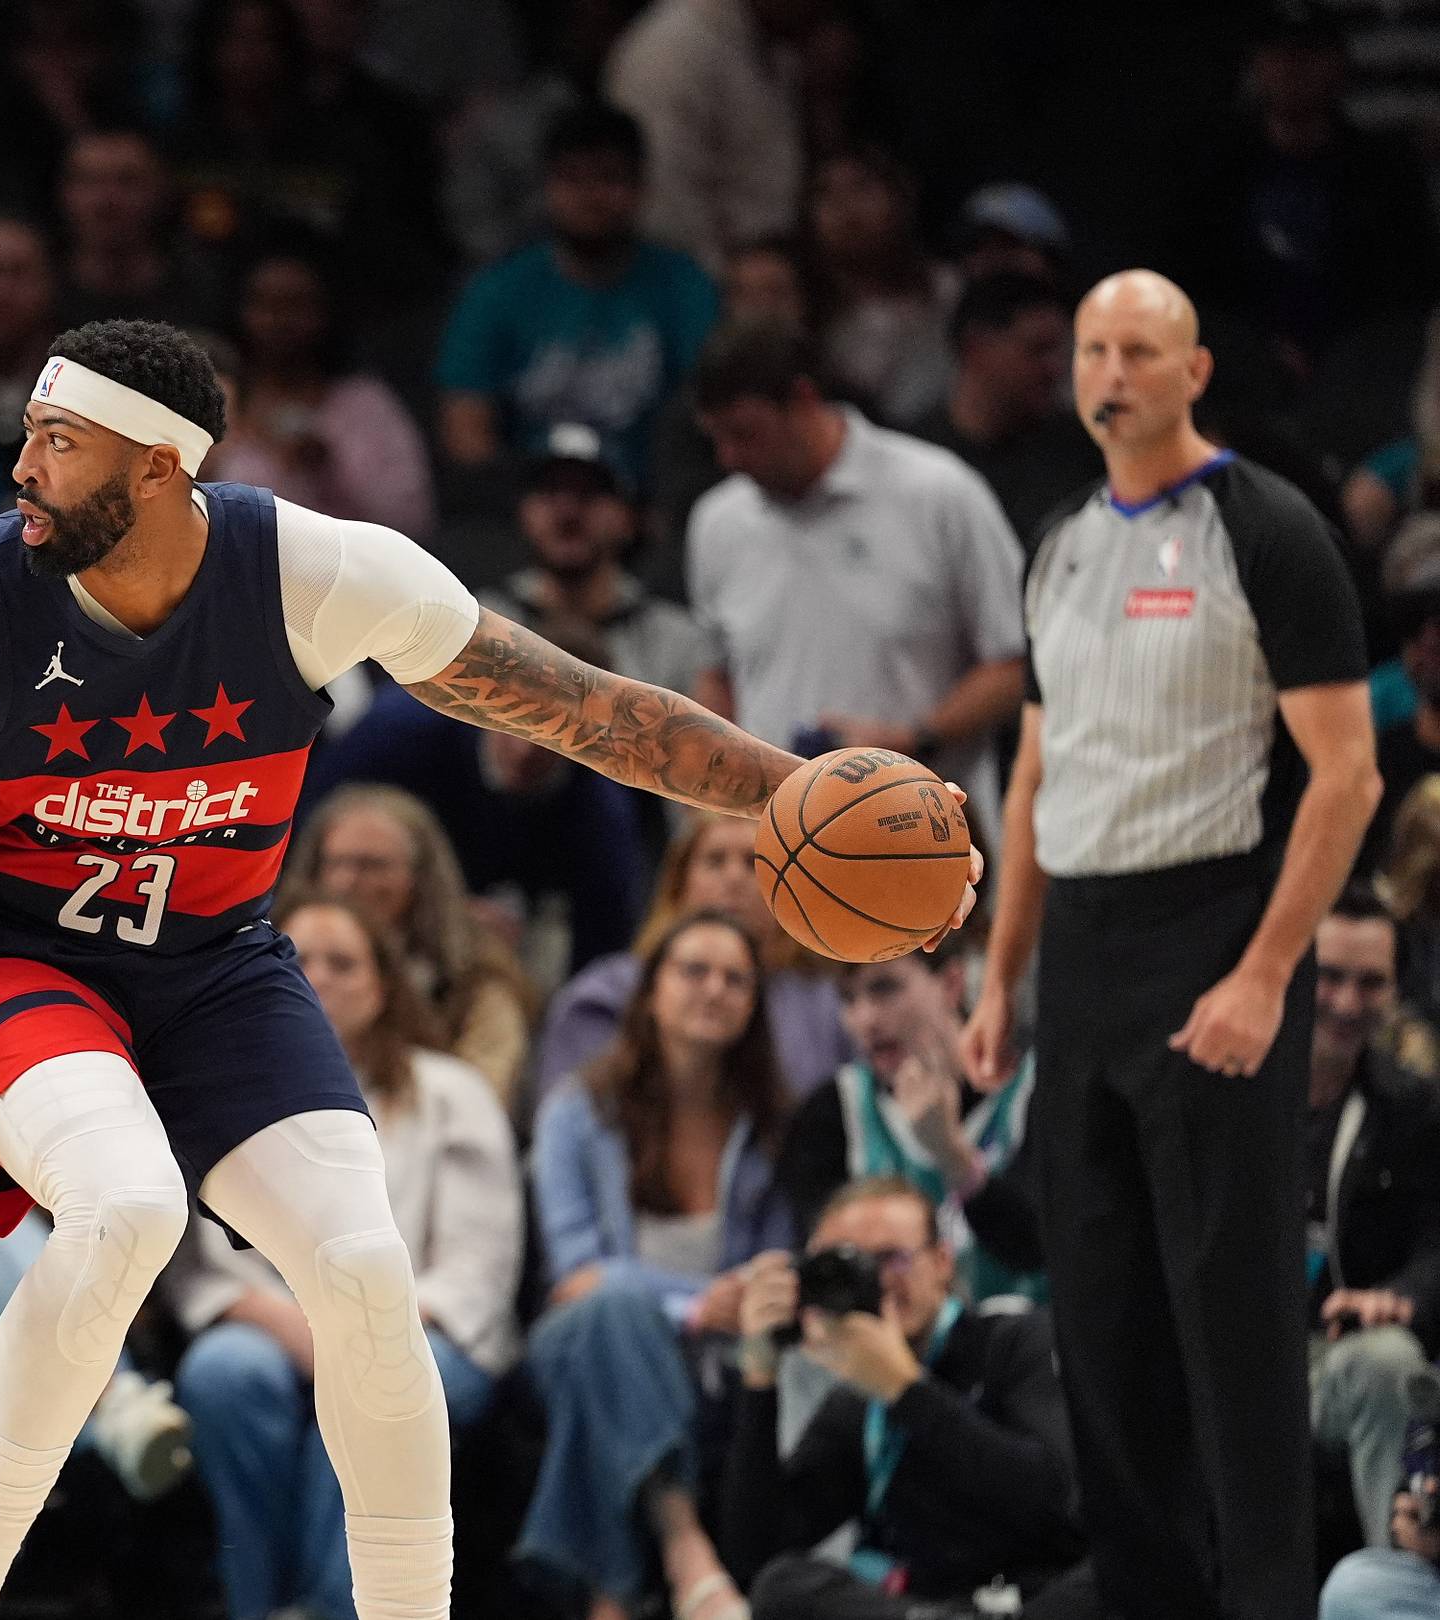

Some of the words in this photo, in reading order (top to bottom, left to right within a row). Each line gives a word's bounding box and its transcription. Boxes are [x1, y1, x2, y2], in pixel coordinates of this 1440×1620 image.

[34, 779, 259, 836] district
[96, 783, 133, 800] THE
[36, 823, 59, 844] OF
[57, 854, 177, 947] 23
